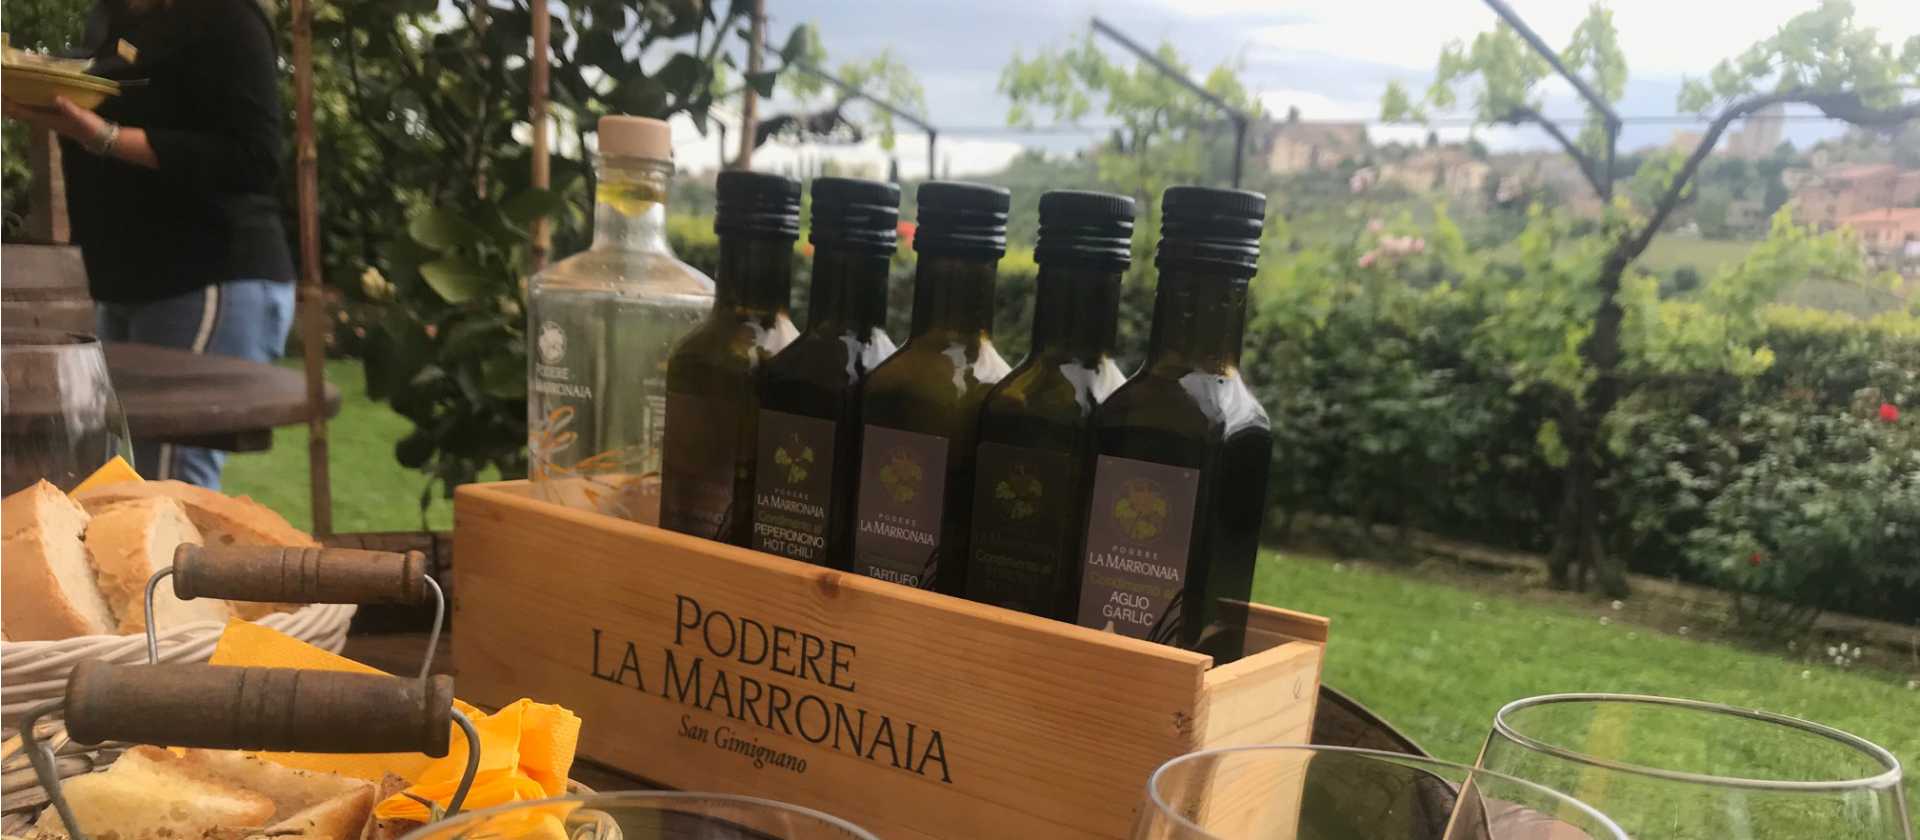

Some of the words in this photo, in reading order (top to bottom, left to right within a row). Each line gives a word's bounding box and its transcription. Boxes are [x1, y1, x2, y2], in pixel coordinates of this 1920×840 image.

[757, 494, 769, 506] LA
[770, 495, 824, 519] MARRONAIA
[754, 522, 824, 548] PEPERONCINO
[860, 519, 873, 532] LA
[874, 521, 935, 546] MARRONAIA
[763, 538, 784, 552] HOT
[786, 543, 814, 560] CHILI
[1111, 545, 1158, 561] PODERE
[869, 565, 919, 587] TARTUFO
[1088, 551, 1104, 566] LA
[1105, 553, 1179, 581] MARRONAIA
[1110, 591, 1150, 610] AGLIO
[1102, 604, 1153, 626] GARLIC
[673, 593, 857, 693] PODERE
[590, 628, 646, 693] LA
[661, 648, 953, 784] MARRONAIA
[677, 714, 708, 744] San
[714, 726, 808, 774] Gimignano
